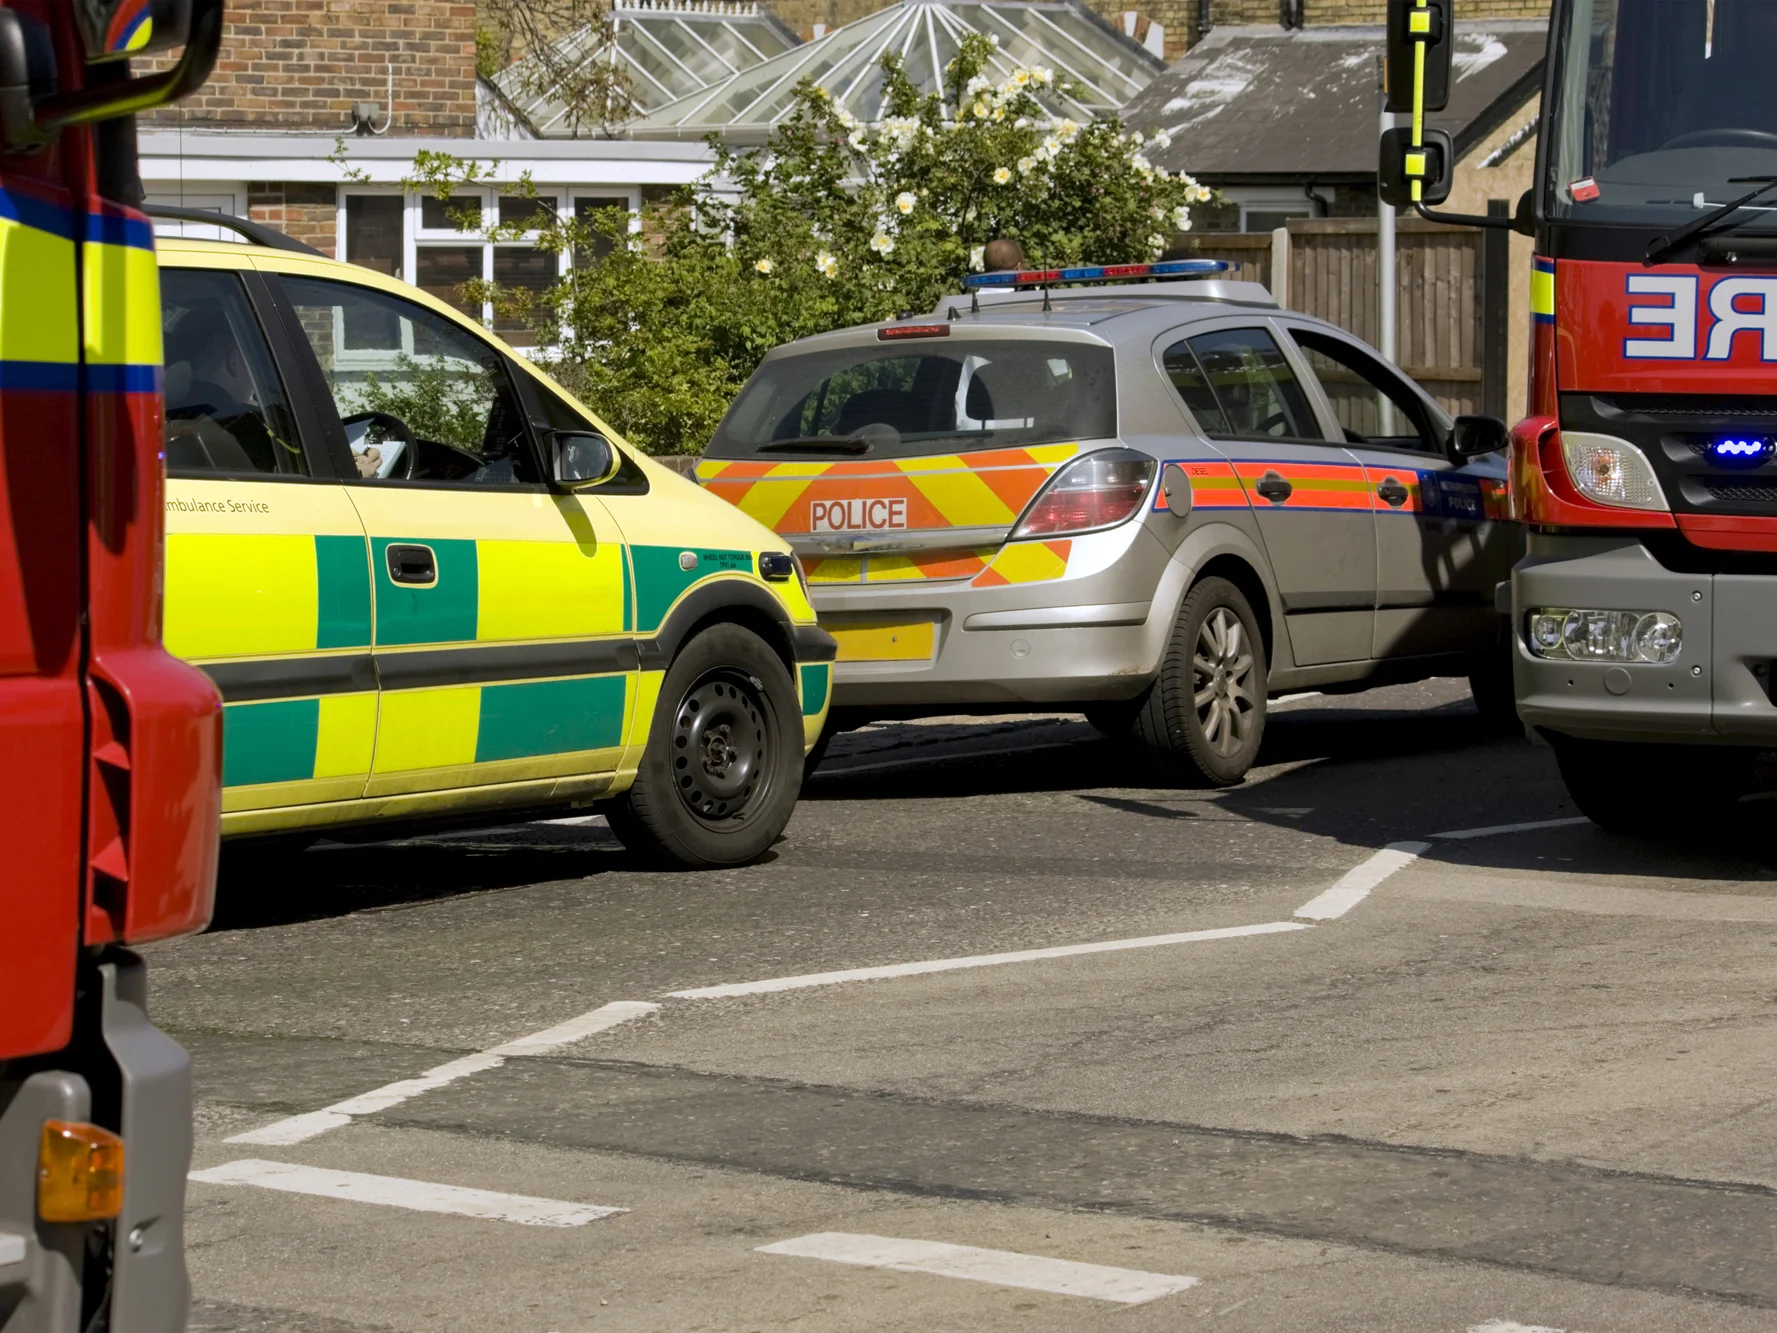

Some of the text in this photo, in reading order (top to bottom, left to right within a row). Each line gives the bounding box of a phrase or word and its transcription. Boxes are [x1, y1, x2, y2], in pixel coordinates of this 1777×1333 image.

[165, 498, 270, 513] mbulance Service
[1448, 496, 1477, 511] POLICE
[812, 499, 905, 531] POLICE
